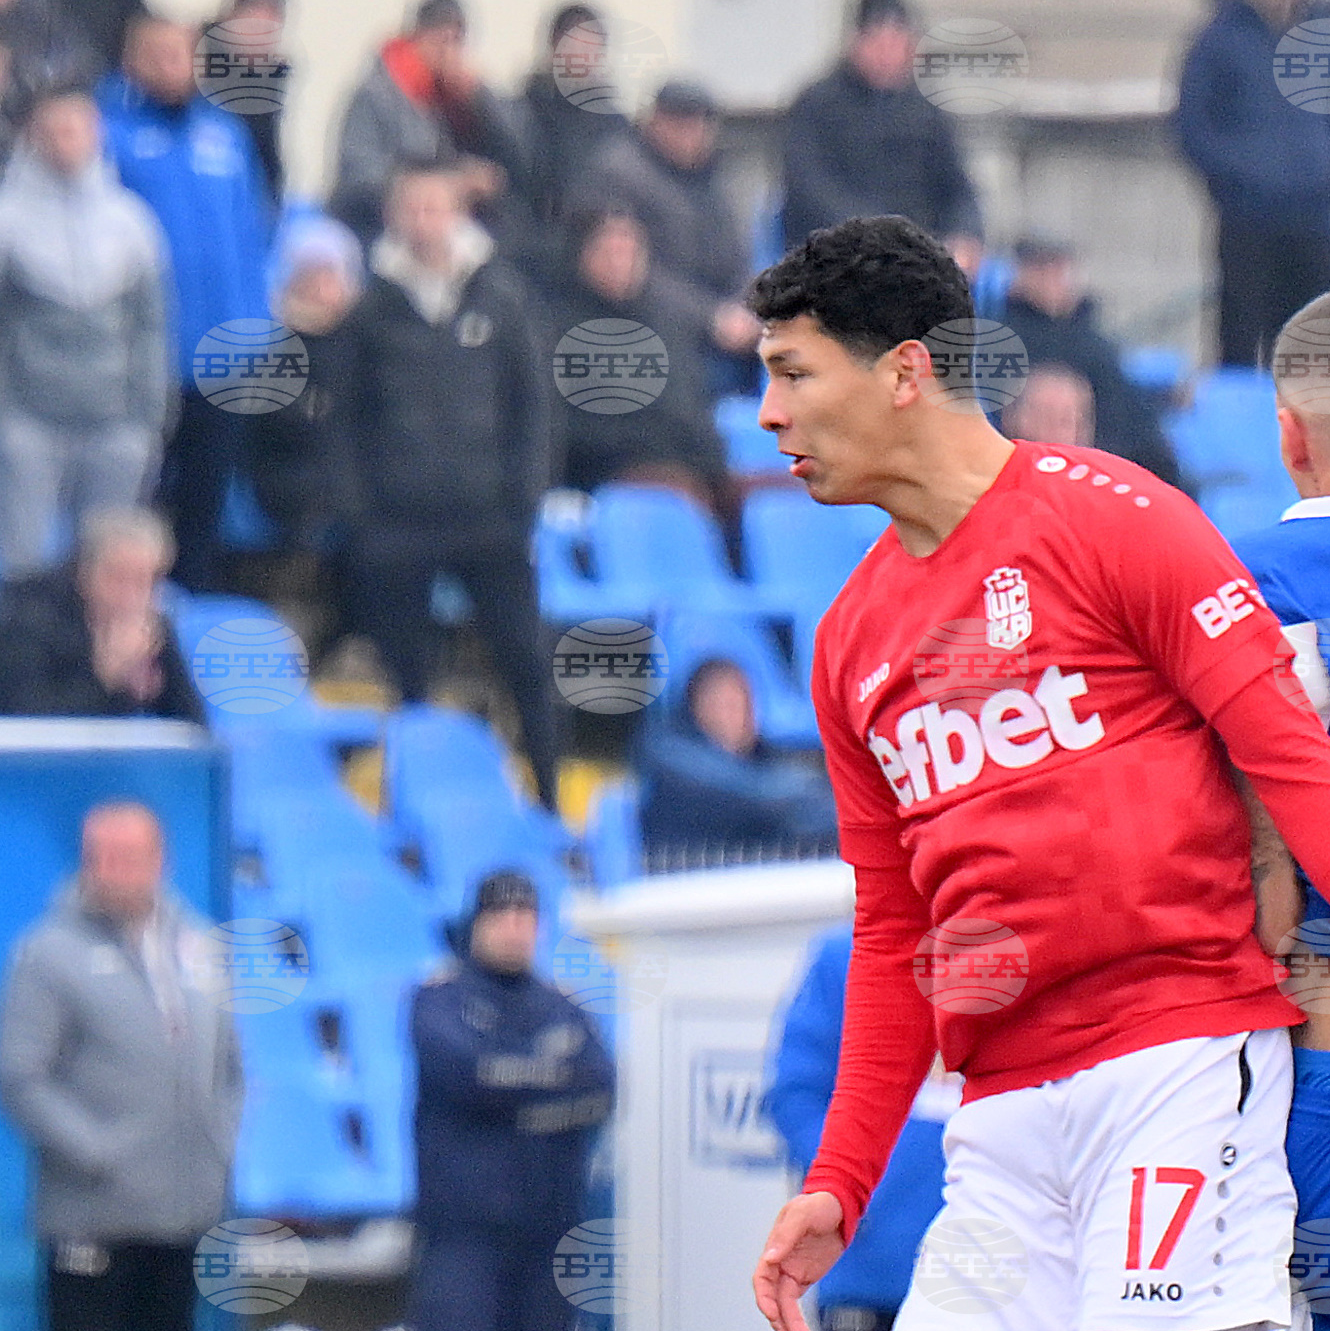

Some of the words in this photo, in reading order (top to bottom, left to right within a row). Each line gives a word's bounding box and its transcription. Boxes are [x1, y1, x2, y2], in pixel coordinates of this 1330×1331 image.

[868, 665, 1106, 808] efbet
[1125, 1166, 1207, 1271] 17
[1120, 1282, 1184, 1302] JAKO
